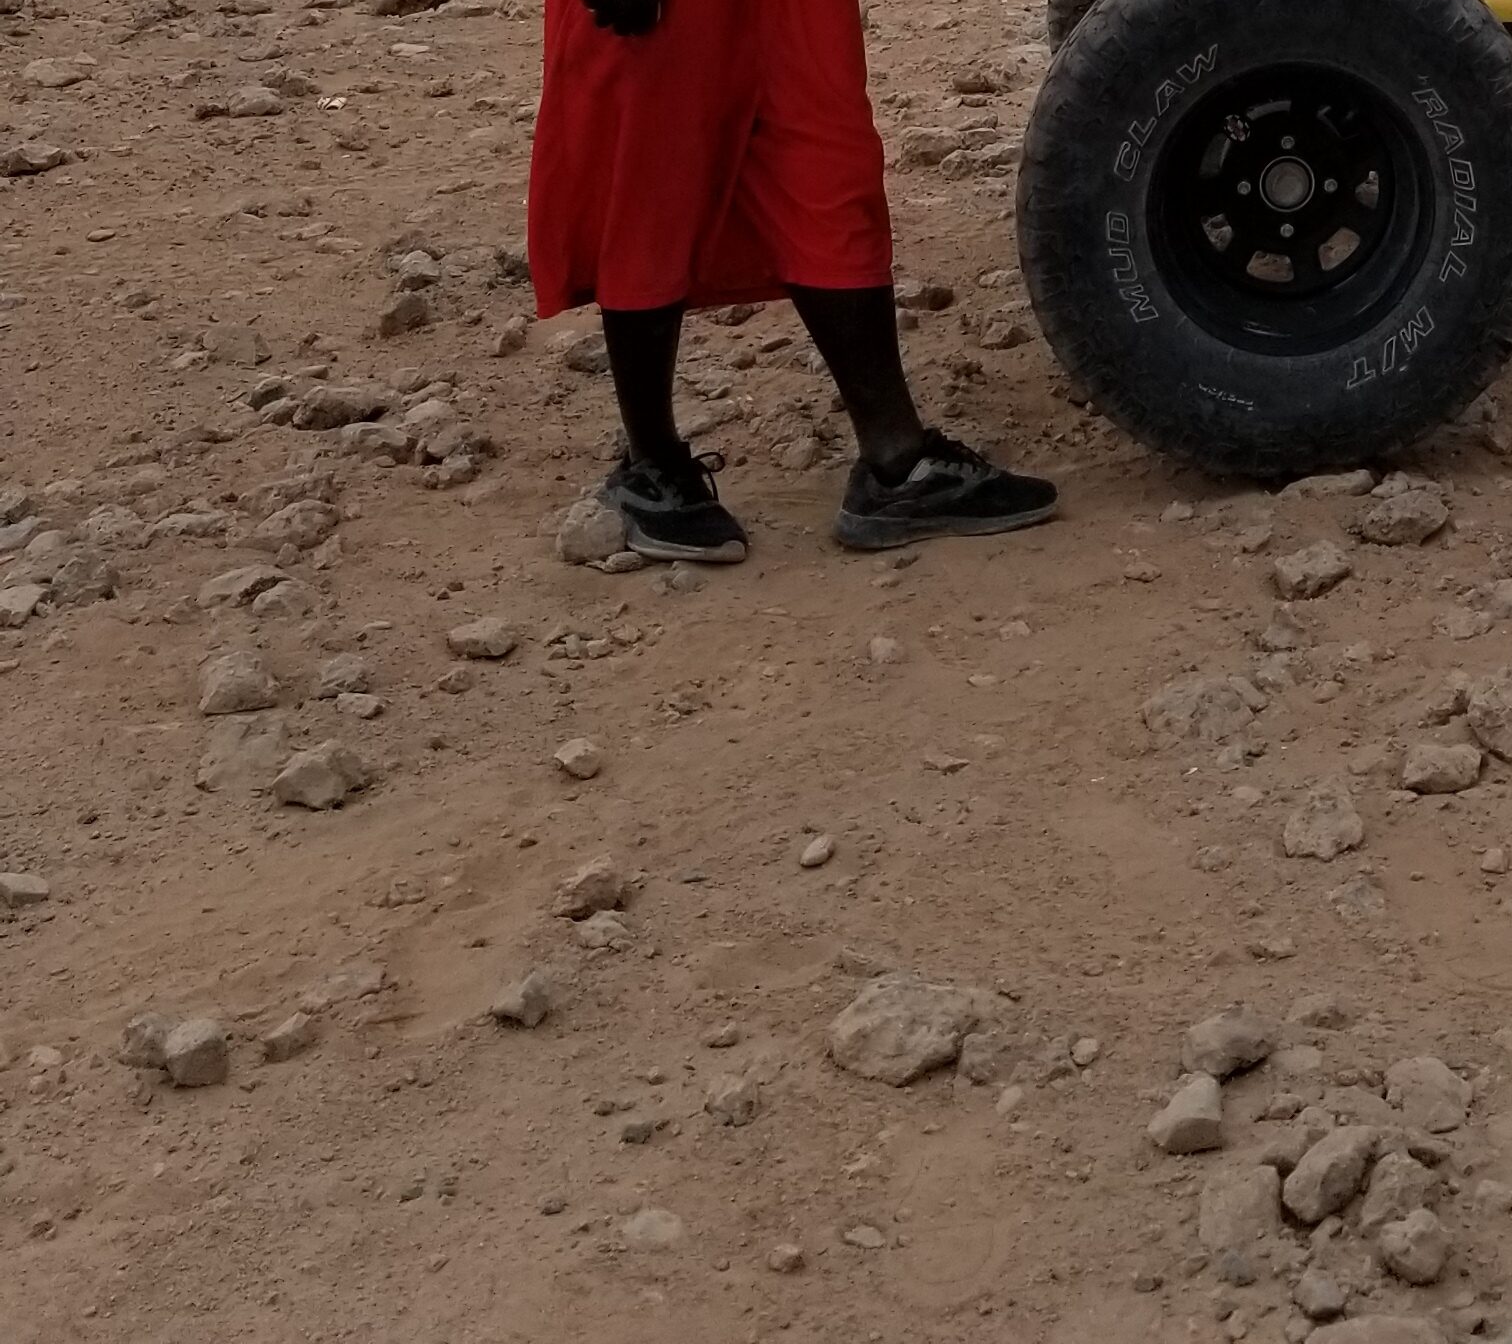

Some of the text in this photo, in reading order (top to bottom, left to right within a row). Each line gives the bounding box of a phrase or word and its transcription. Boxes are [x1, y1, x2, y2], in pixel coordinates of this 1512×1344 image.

[1105, 43, 1219, 323] MUD CLAW
[1411, 87, 1477, 283] RADIAL
